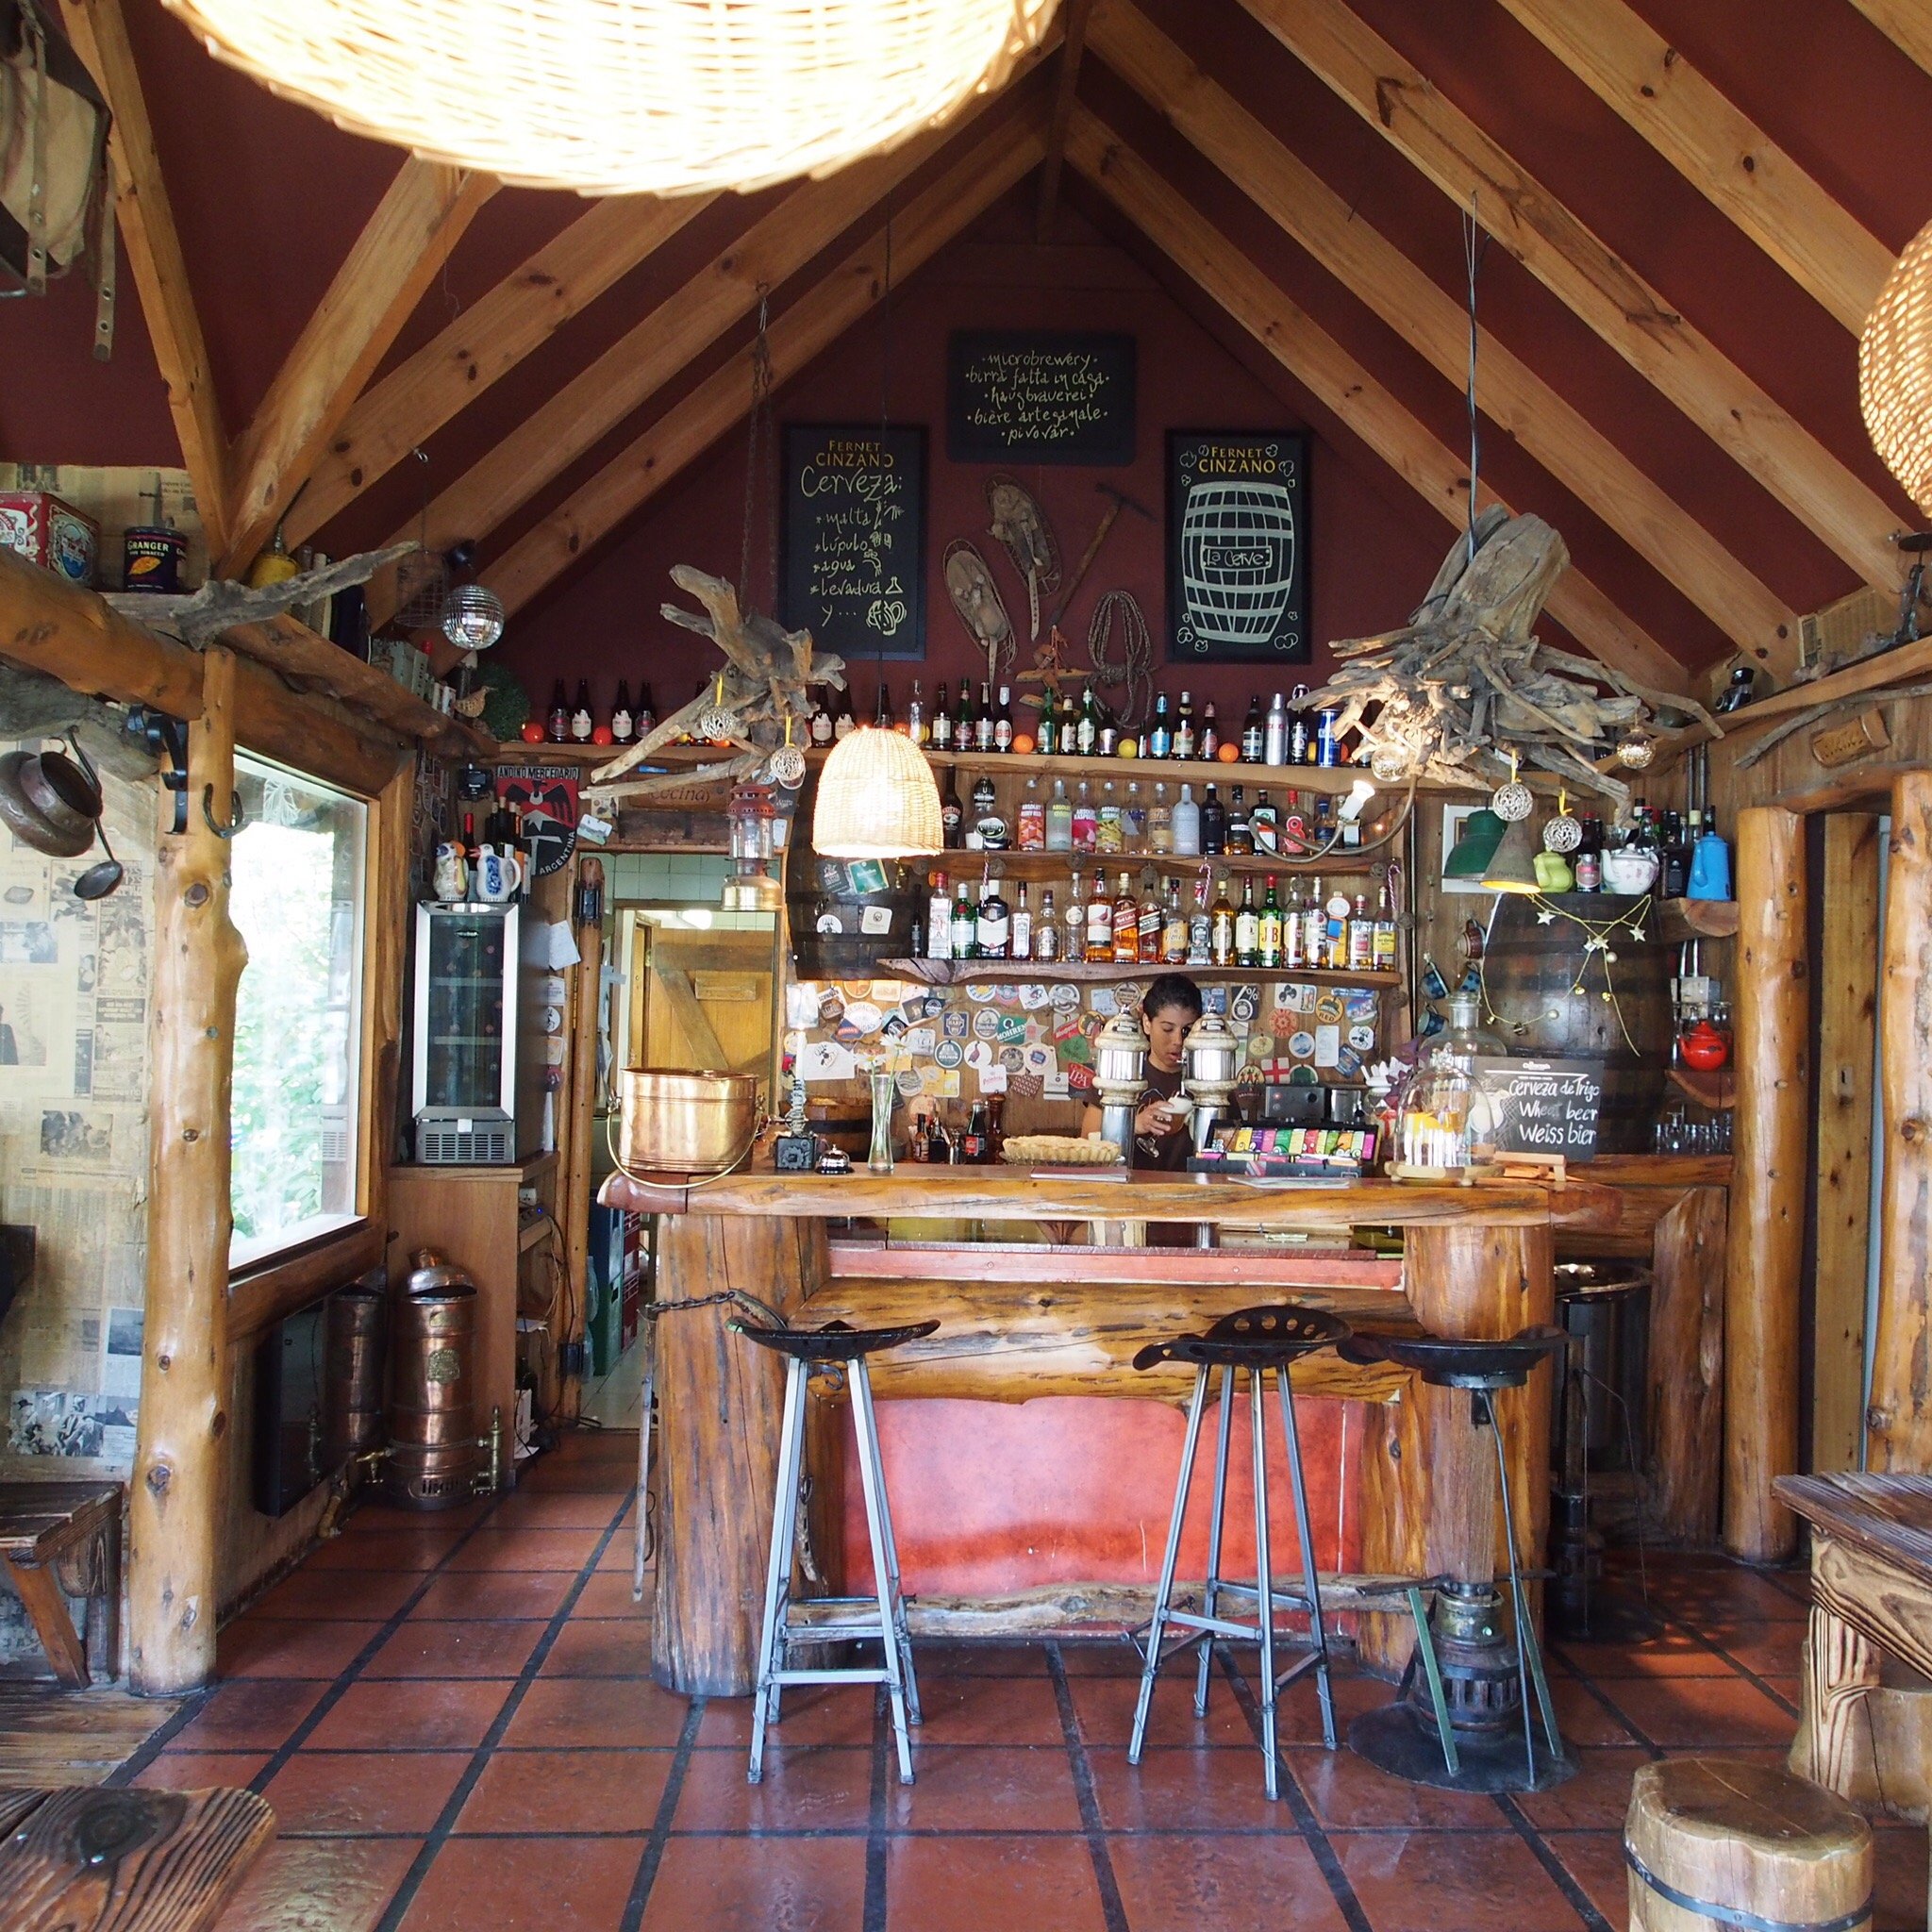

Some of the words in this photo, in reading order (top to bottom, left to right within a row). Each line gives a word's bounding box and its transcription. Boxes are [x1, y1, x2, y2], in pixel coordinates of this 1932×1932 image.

[1055, 374, 1069, 391] in
[829, 440, 881, 452] FERNET
[1211, 446, 1262, 458] FERNET
[816, 452, 894, 468] CINZANO
[1198, 458, 1275, 473] CINZANO
[127, 541, 169, 552] GRANGER
[1208, 548, 1221, 566] La
[1224, 549, 1264, 567] Cerve
[498, 766, 526, 778] ANDINO
[528, 767, 578, 780] MERCEDARIO
[539, 830, 576, 876] ARGENTINA
[1069, 1068, 1088, 1087] IPA
[1509, 1079, 1558, 1097] Cerveza
[1559, 1079, 1574, 1095] de
[1573, 1074, 1600, 1103] Trigo
[1566, 1100, 1598, 1122] beer
[1519, 1123, 1564, 1144] Weiss
[1568, 1122, 1597, 1145] bier
